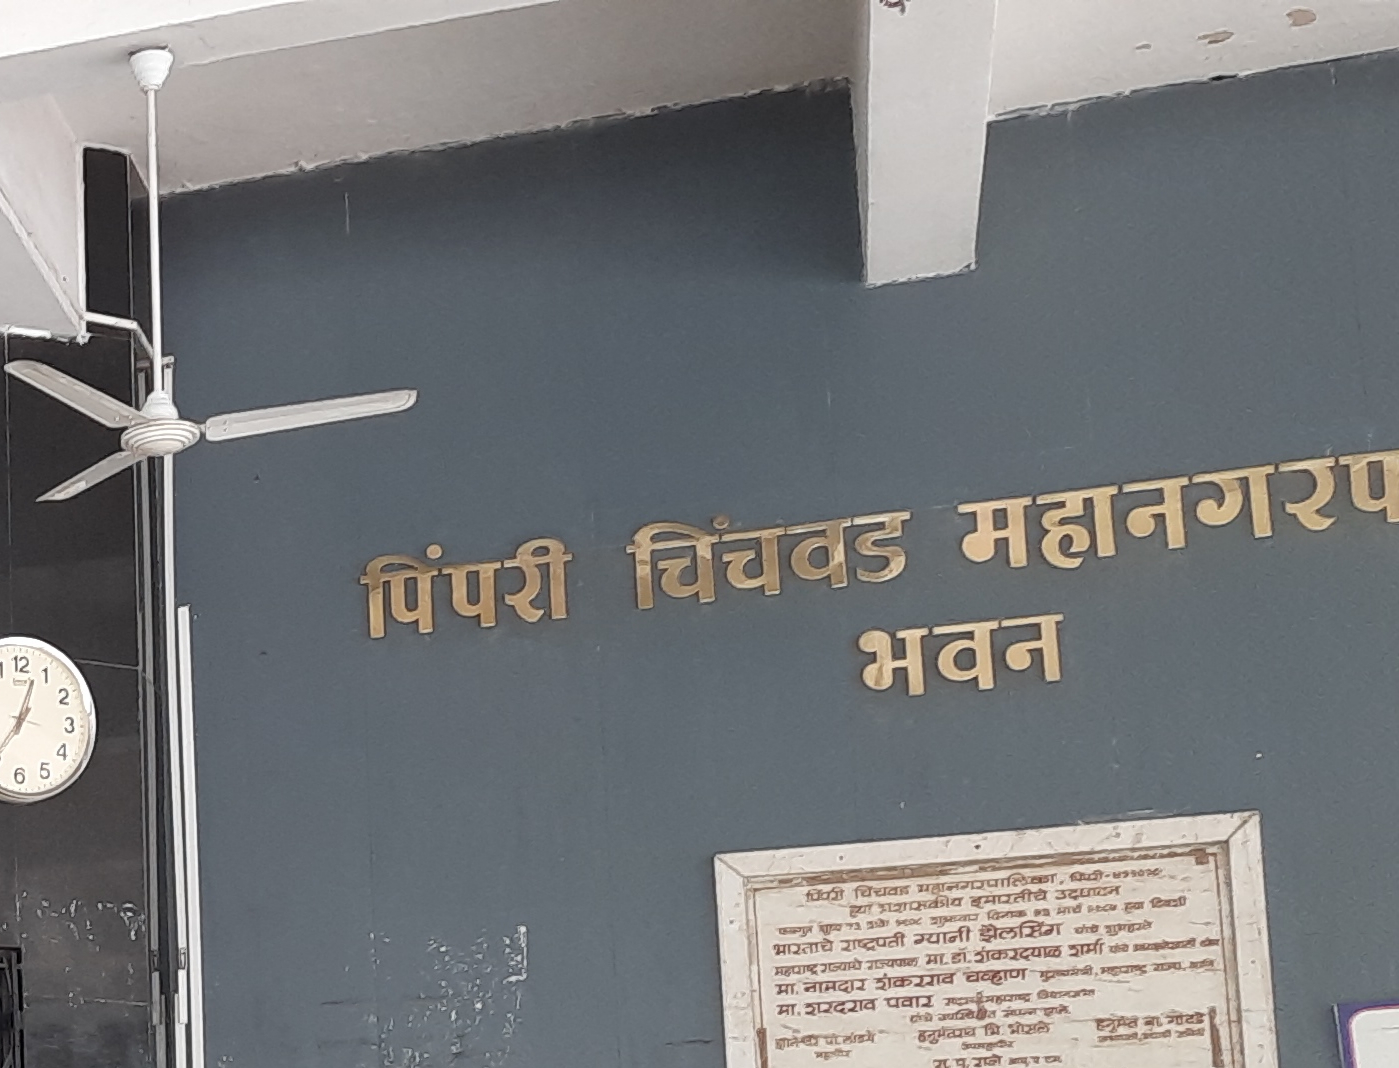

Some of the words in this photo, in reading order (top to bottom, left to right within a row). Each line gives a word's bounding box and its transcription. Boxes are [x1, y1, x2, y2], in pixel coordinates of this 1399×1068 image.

[360, 538, 573, 639] पिंपरी
[625, 509, 912, 609] चिंचवड
[858, 612, 1064, 697] भवन
[12, 655, 31, 674] 12
[41, 666, 49, 684] 1
[58, 688, 70, 705] 2
[64, 716, 75, 734] 3
[56, 743, 68, 761] 4
[14, 767, 26, 784] 6
[39, 762, 51, 779] 5
[772, 938, 834, 956] भारताचे
[840, 932, 906, 950] राष्ट्रपती
[914, 926, 971, 945] ग्यानी
[1068, 938, 1105, 957] शर्मा
[803, 978, 868, 995] नामदार
[873, 972, 956, 991] शंकरराव
[963, 967, 1028, 986] चव्हाण
[883, 994, 934, 1009] पवार
